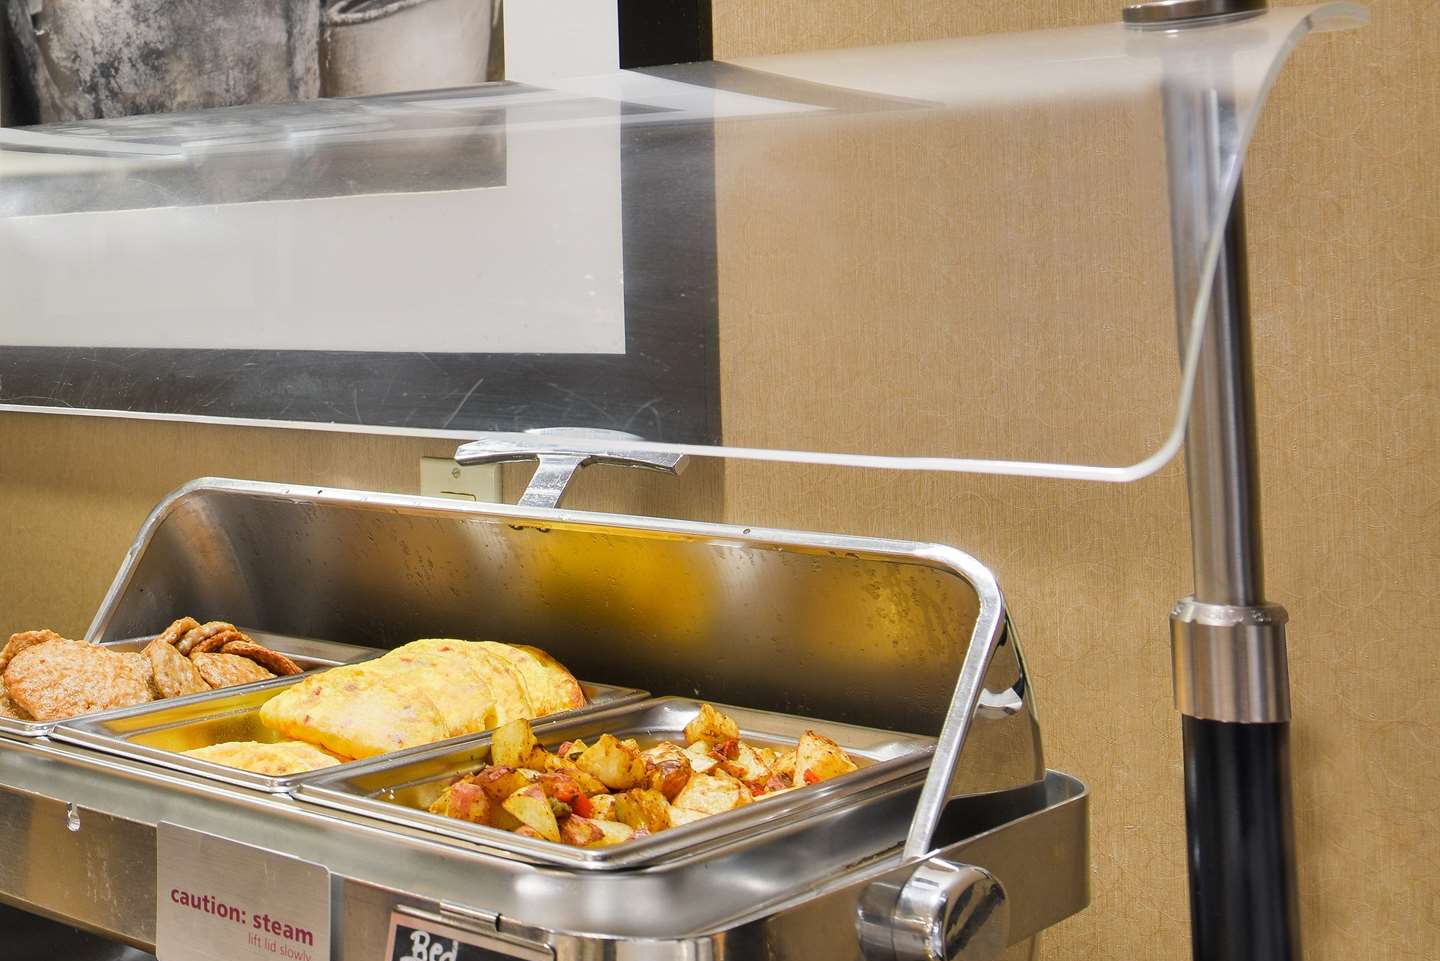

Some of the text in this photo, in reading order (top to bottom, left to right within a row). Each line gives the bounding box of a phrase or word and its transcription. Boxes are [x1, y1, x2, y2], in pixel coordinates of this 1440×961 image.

[171, 888, 314, 946] caution: steam
[248, 932, 262, 947] lift
[264, 937, 277, 953] lid
